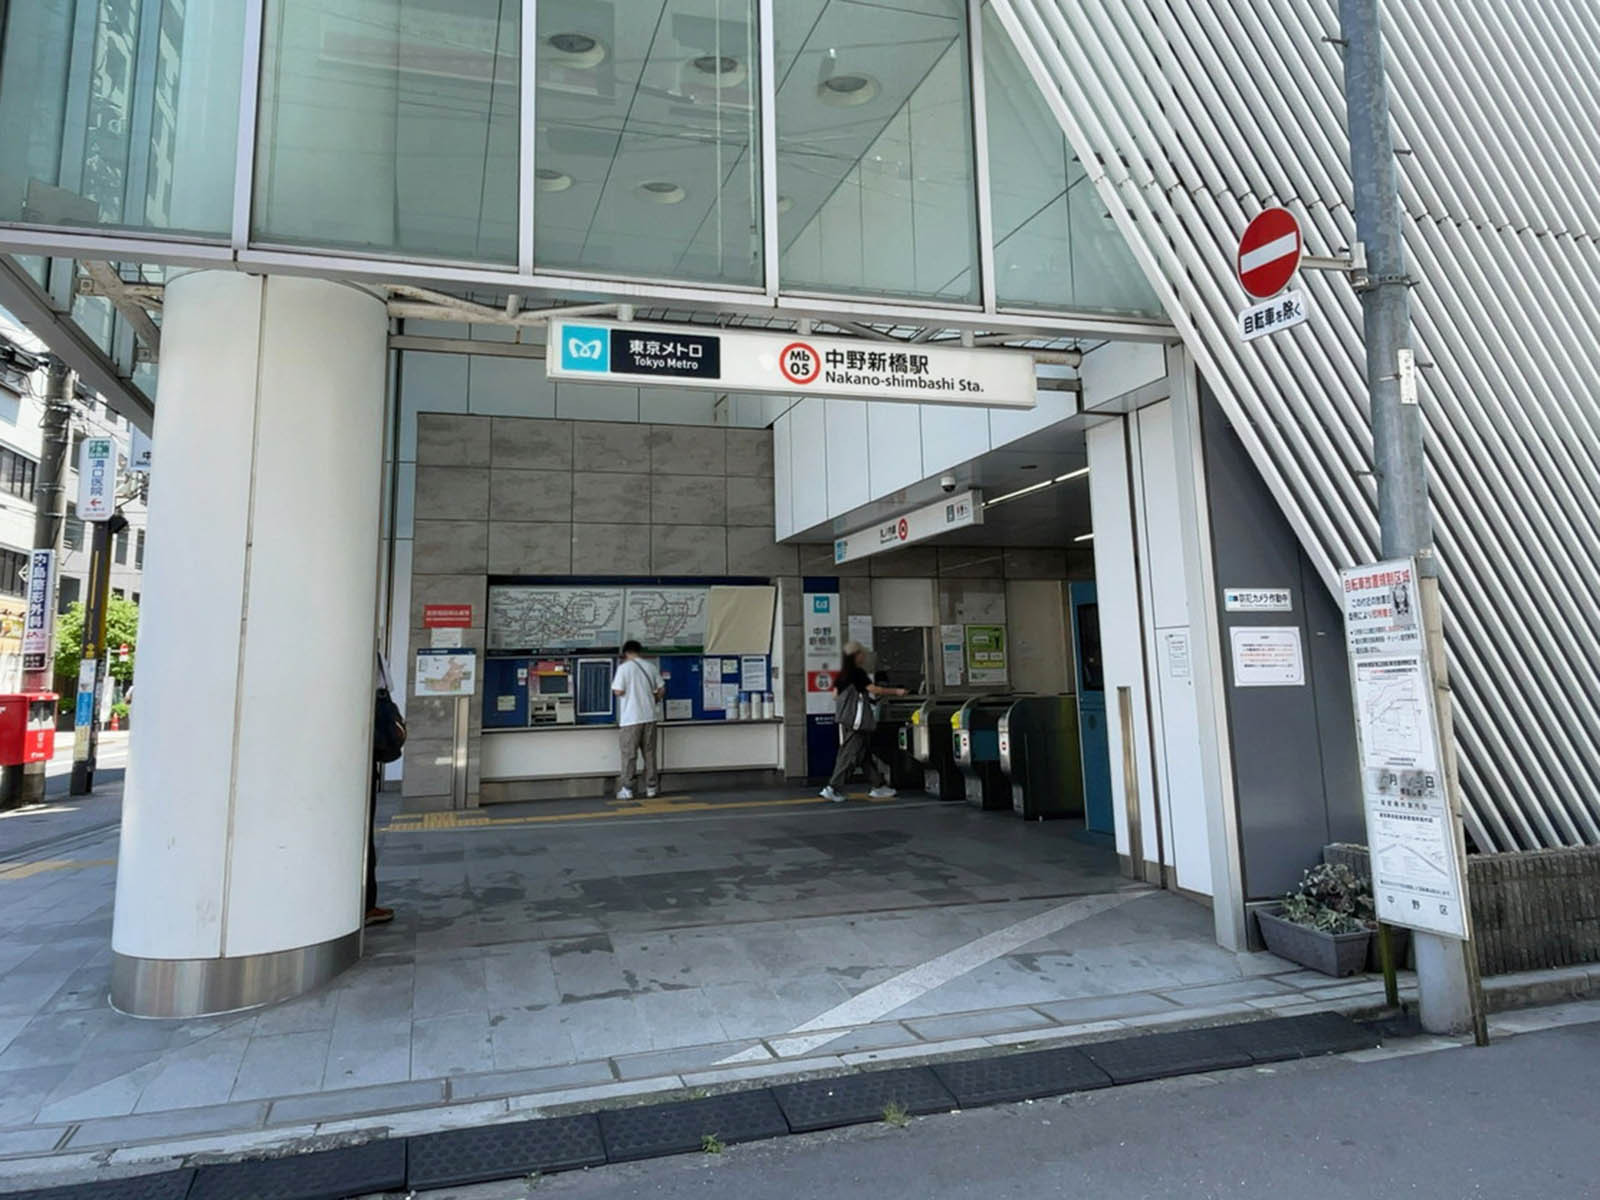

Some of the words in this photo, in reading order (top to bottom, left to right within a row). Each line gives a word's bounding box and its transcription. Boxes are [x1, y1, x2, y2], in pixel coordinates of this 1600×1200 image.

[1244, 300, 1302, 334] 自転車を除く
[629, 339, 703, 358] 東京メトロ
[789, 350, 810, 362] Mb
[633, 355, 665, 368] Tokyo
[667, 357, 698, 370] Metro
[790, 362, 810, 376] 05
[825, 348, 929, 375] 中野新橋駅
[825, 370, 955, 391] Nakano-shimbashi
[959, 378, 985, 392] Sta.
